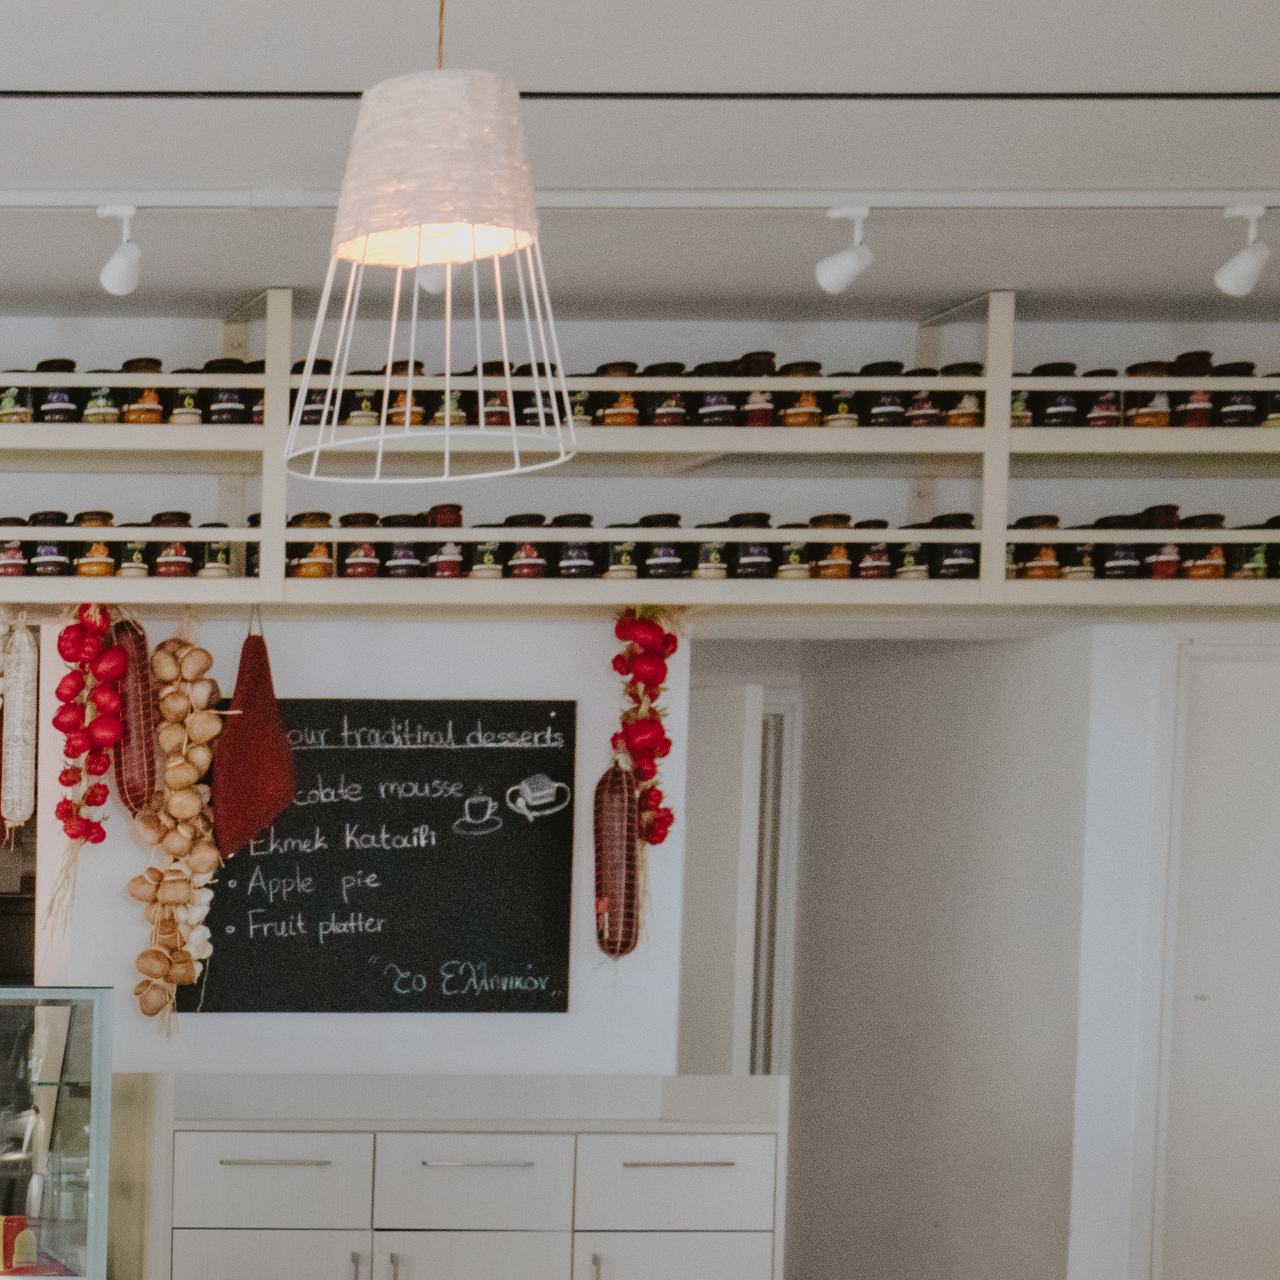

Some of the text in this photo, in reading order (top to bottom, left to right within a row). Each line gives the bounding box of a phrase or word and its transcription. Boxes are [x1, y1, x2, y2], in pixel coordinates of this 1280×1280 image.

[466, 717, 565, 748] desserts
[292, 772, 465, 806] colate mousse
[248, 864, 382, 904] Apple pie
[248, 908, 387, 945] Fruit platter
